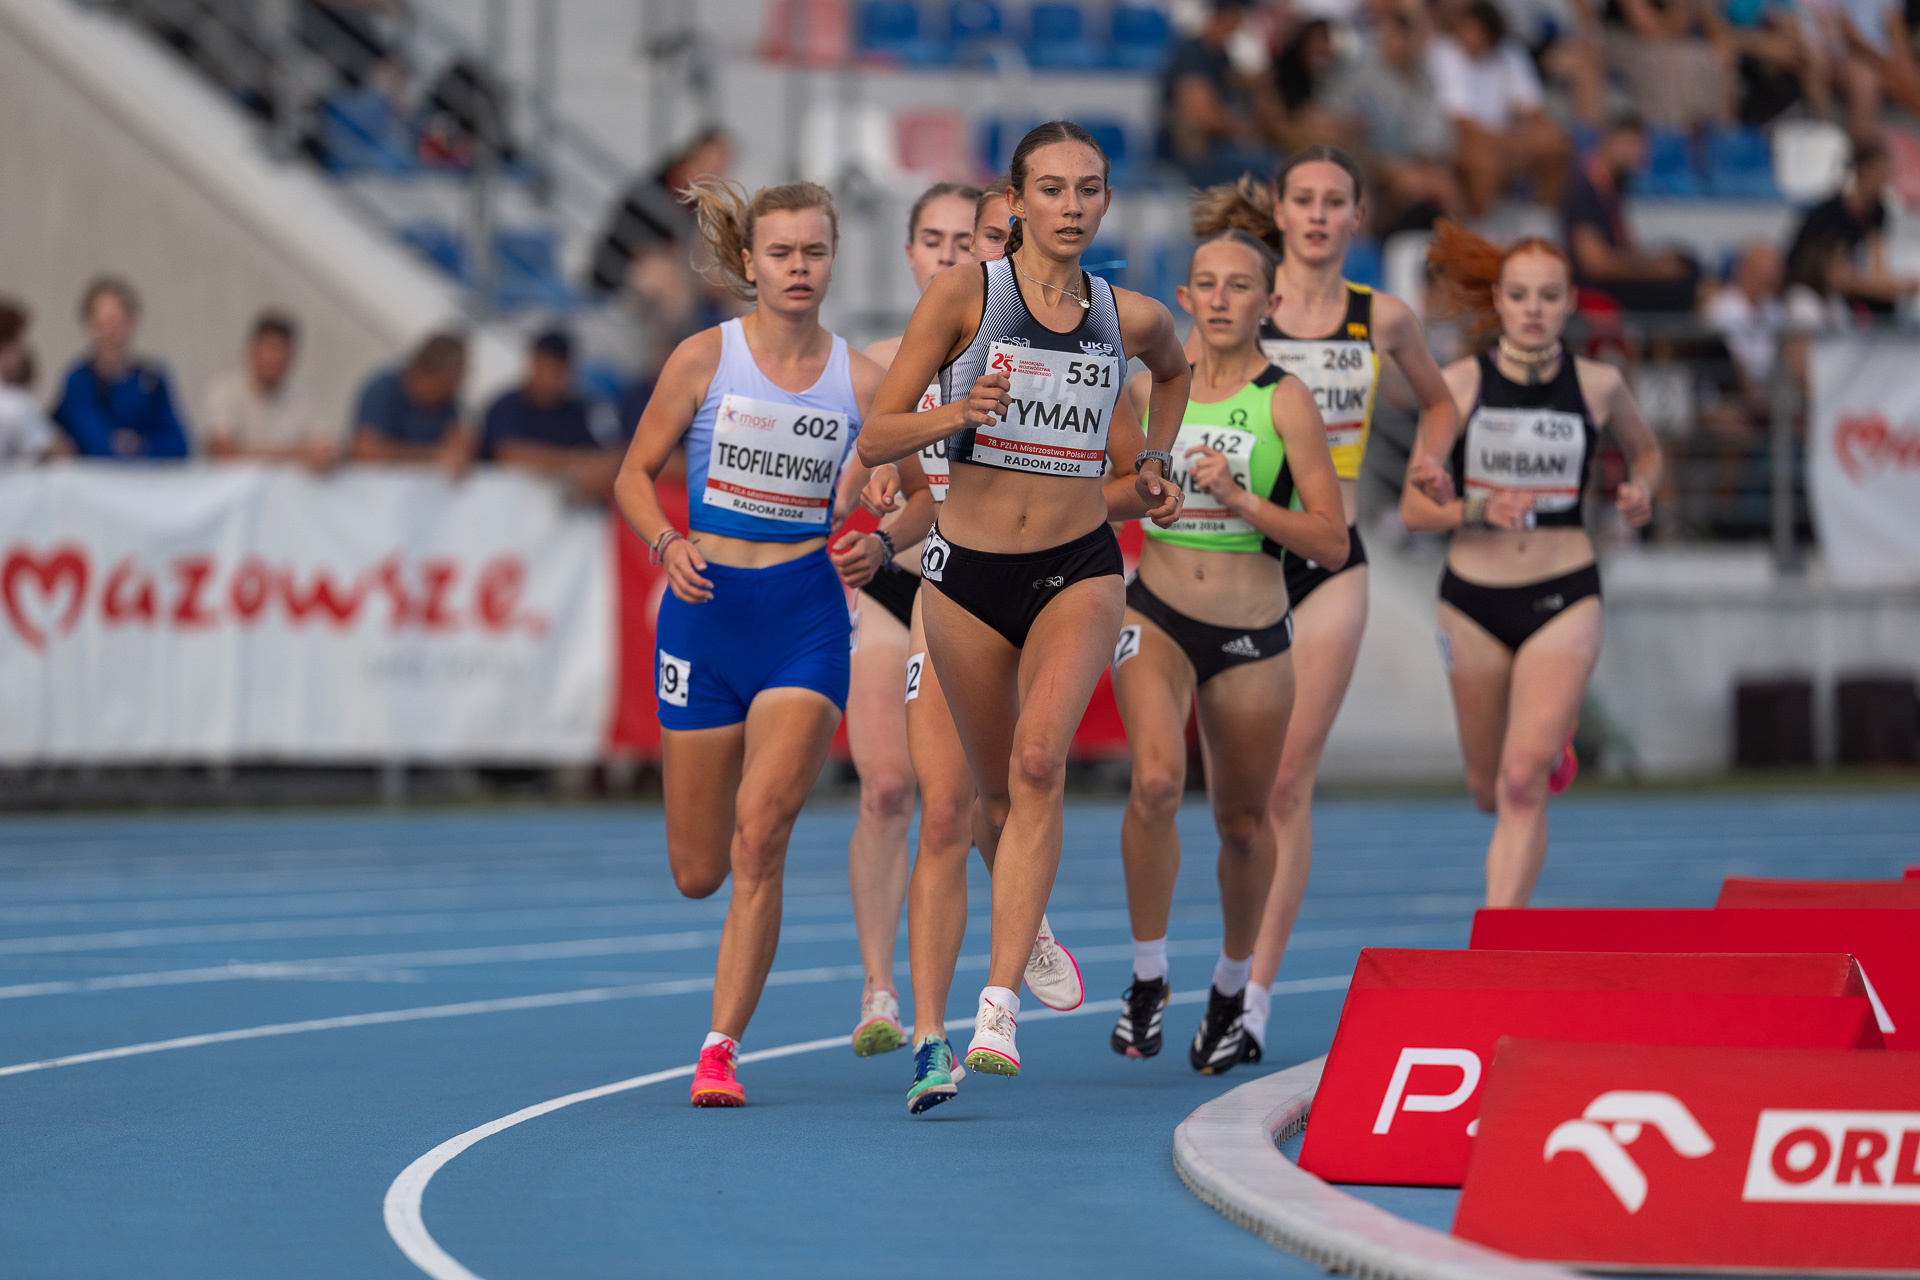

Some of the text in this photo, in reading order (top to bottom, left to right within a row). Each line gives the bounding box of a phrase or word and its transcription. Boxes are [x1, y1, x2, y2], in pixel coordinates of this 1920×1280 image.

[1079, 341, 1114, 352] UKS
[1323, 348, 1363, 370] 268
[1066, 361, 1111, 388] 531
[739, 412, 778, 429] mosir
[793, 415, 839, 441] 602
[987, 438, 999, 447] 78.
[1000, 441, 1018, 451] PZLA
[1019, 444, 1065, 457] Mistrzostwa
[1066, 450, 1087, 459] Polski
[1201, 432, 1242, 455] 162
[718, 442, 833, 484] TEOFILEWSKA
[1003, 454, 1080, 474] RADOM 2024
[1481, 451, 1566, 477] URBAN
[732, 499, 804, 519] RADOM 2024
[906, 661, 921, 694] 2
[1372, 1047, 1482, 1136] P
